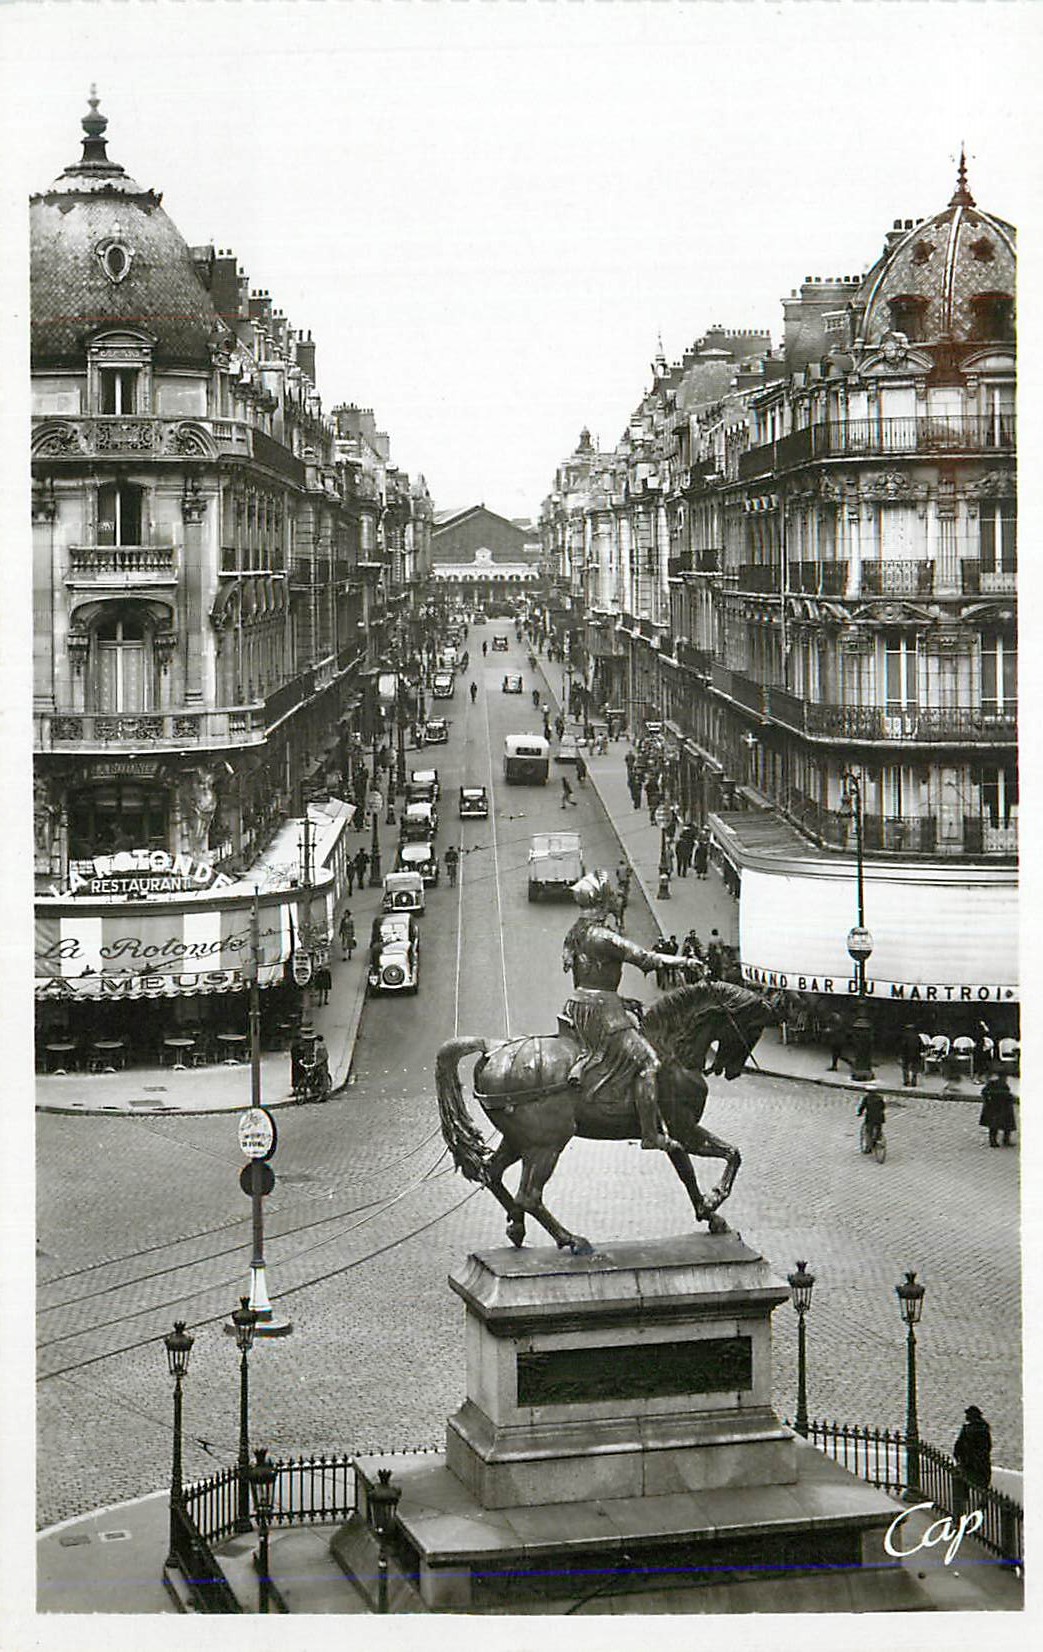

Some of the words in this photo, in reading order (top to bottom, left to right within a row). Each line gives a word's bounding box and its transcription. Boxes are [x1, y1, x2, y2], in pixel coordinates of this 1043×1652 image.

[49, 870, 89, 898] LA
[93, 849, 233, 891] ROTONDE
[91, 877, 190, 894] RESTAURANT
[34, 937, 85, 960] La
[100, 931, 246, 959] Rotonde
[798, 977, 834, 993] BAR
[849, 979, 875, 996] DU
[891, 984, 1001, 1000] MARTROI
